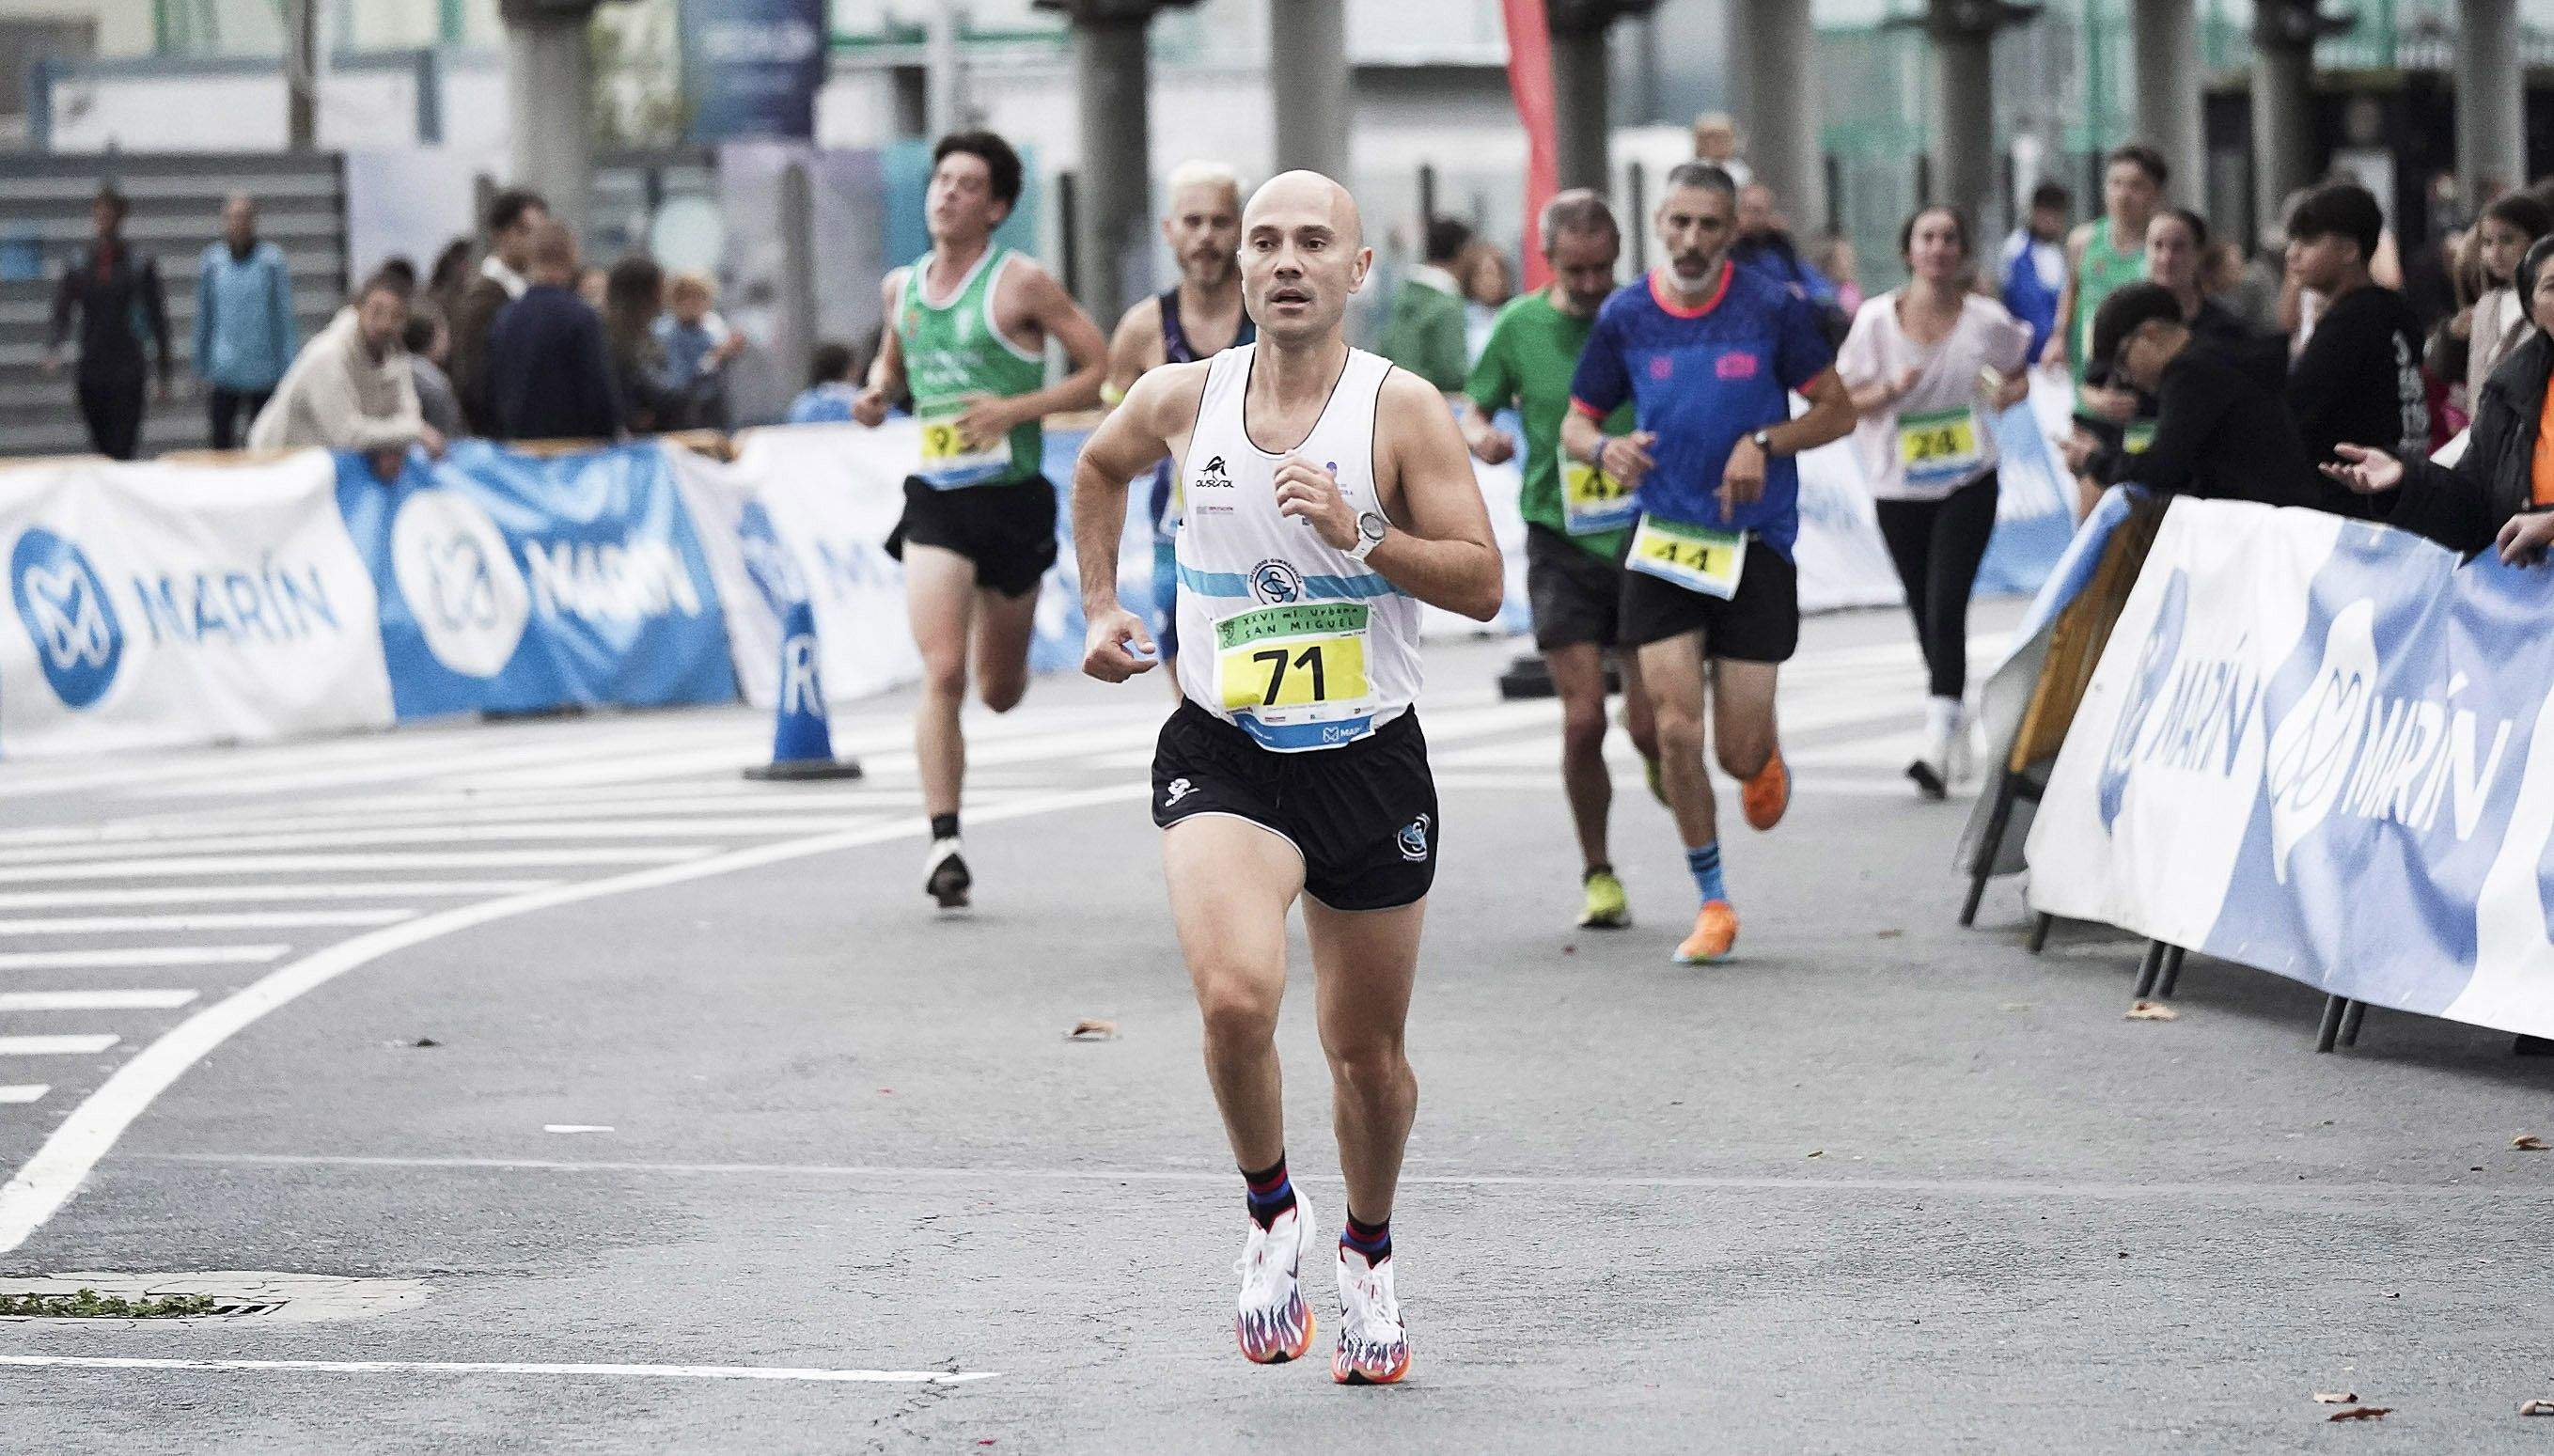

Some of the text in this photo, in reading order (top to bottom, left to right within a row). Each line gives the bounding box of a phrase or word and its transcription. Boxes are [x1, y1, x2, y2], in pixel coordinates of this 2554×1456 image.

[1654, 541, 1709, 571] 44
[132, 549, 343, 644] MARÍN
[1244, 612, 1275, 626] XXVI
[1245, 618, 1354, 639] SAN MIGUEL
[786, 634, 823, 716] R
[1253, 645, 1325, 706] 71
[2143, 633, 2259, 777] MARÍN
[2340, 670, 2514, 841] MARÍN
